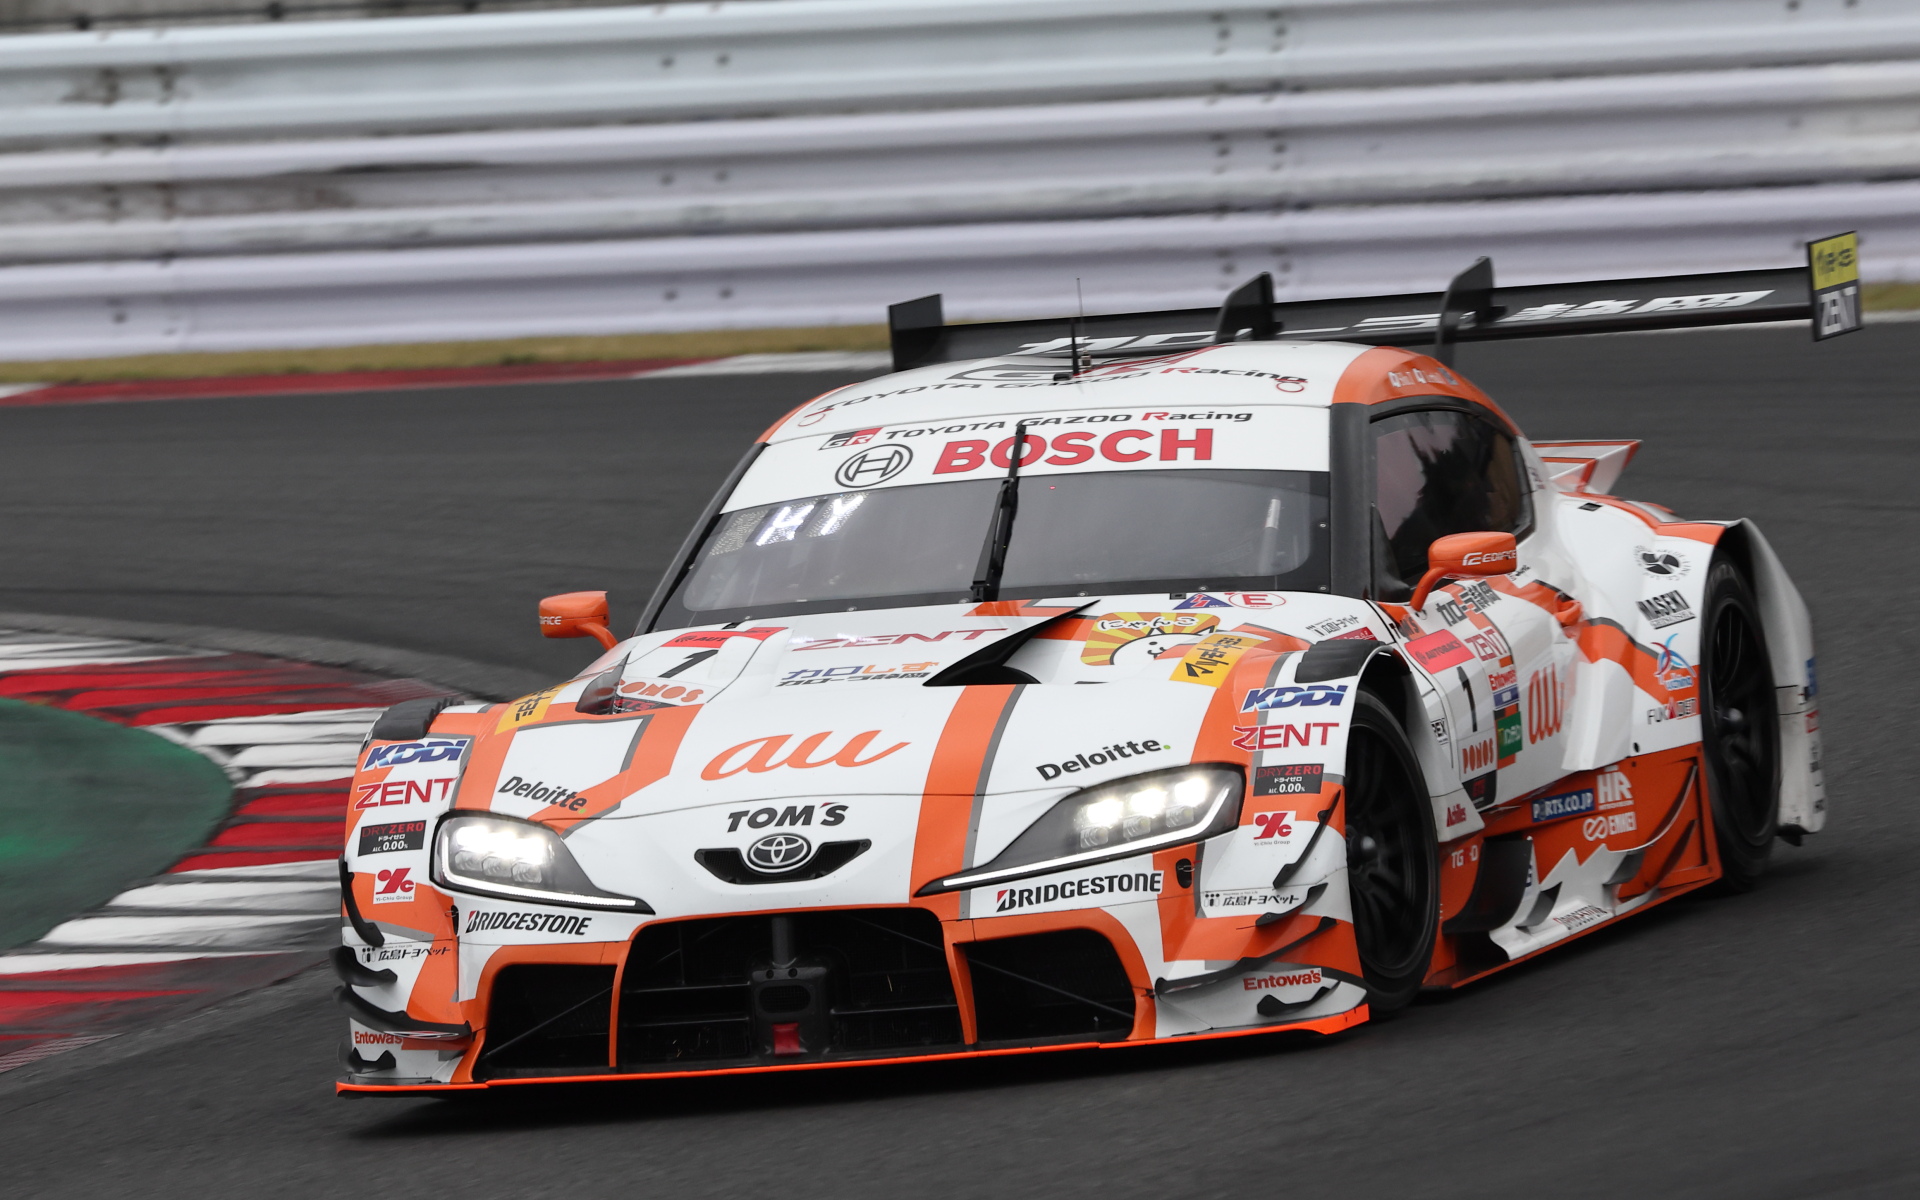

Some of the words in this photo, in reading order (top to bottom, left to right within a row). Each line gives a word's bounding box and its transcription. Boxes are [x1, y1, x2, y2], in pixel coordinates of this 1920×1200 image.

[818, 383, 982, 411] TOYOTA
[1160, 367, 1307, 383] Racing
[885, 421, 1006, 440] TOYOTA
[1016, 414, 1131, 427] GAZOO
[1141, 411, 1252, 422] Racing
[932, 428, 1213, 475] BOSCH
[1099, 616, 1197, 631] にゃんこ
[792, 628, 968, 652] ZENT
[1464, 629, 1508, 662] ZENT
[659, 649, 719, 679] 1
[1241, 685, 1348, 712] KDDI
[1457, 665, 1477, 733] 1
[1528, 661, 1566, 746] au
[1233, 722, 1340, 751] ZENT
[362, 739, 469, 771] KDDI
[700, 729, 912, 781] au
[1462, 738, 1494, 774] PONOS
[1257, 767, 1284, 778] DRY
[1285, 765, 1322, 776] ZERO
[354, 777, 460, 811] ZENT
[362, 826, 389, 837] DRY
[389, 822, 424, 834] ZERO
[727, 802, 849, 833] TOM'S
[996, 872, 1162, 912] BRIDGESTONE
[1222, 895, 1299, 906] 広島トヨペット
[465, 911, 592, 936] BRIDGESTONE
[378, 947, 451, 961] 広島トヨペット
[1243, 970, 1322, 990] Entowa's
